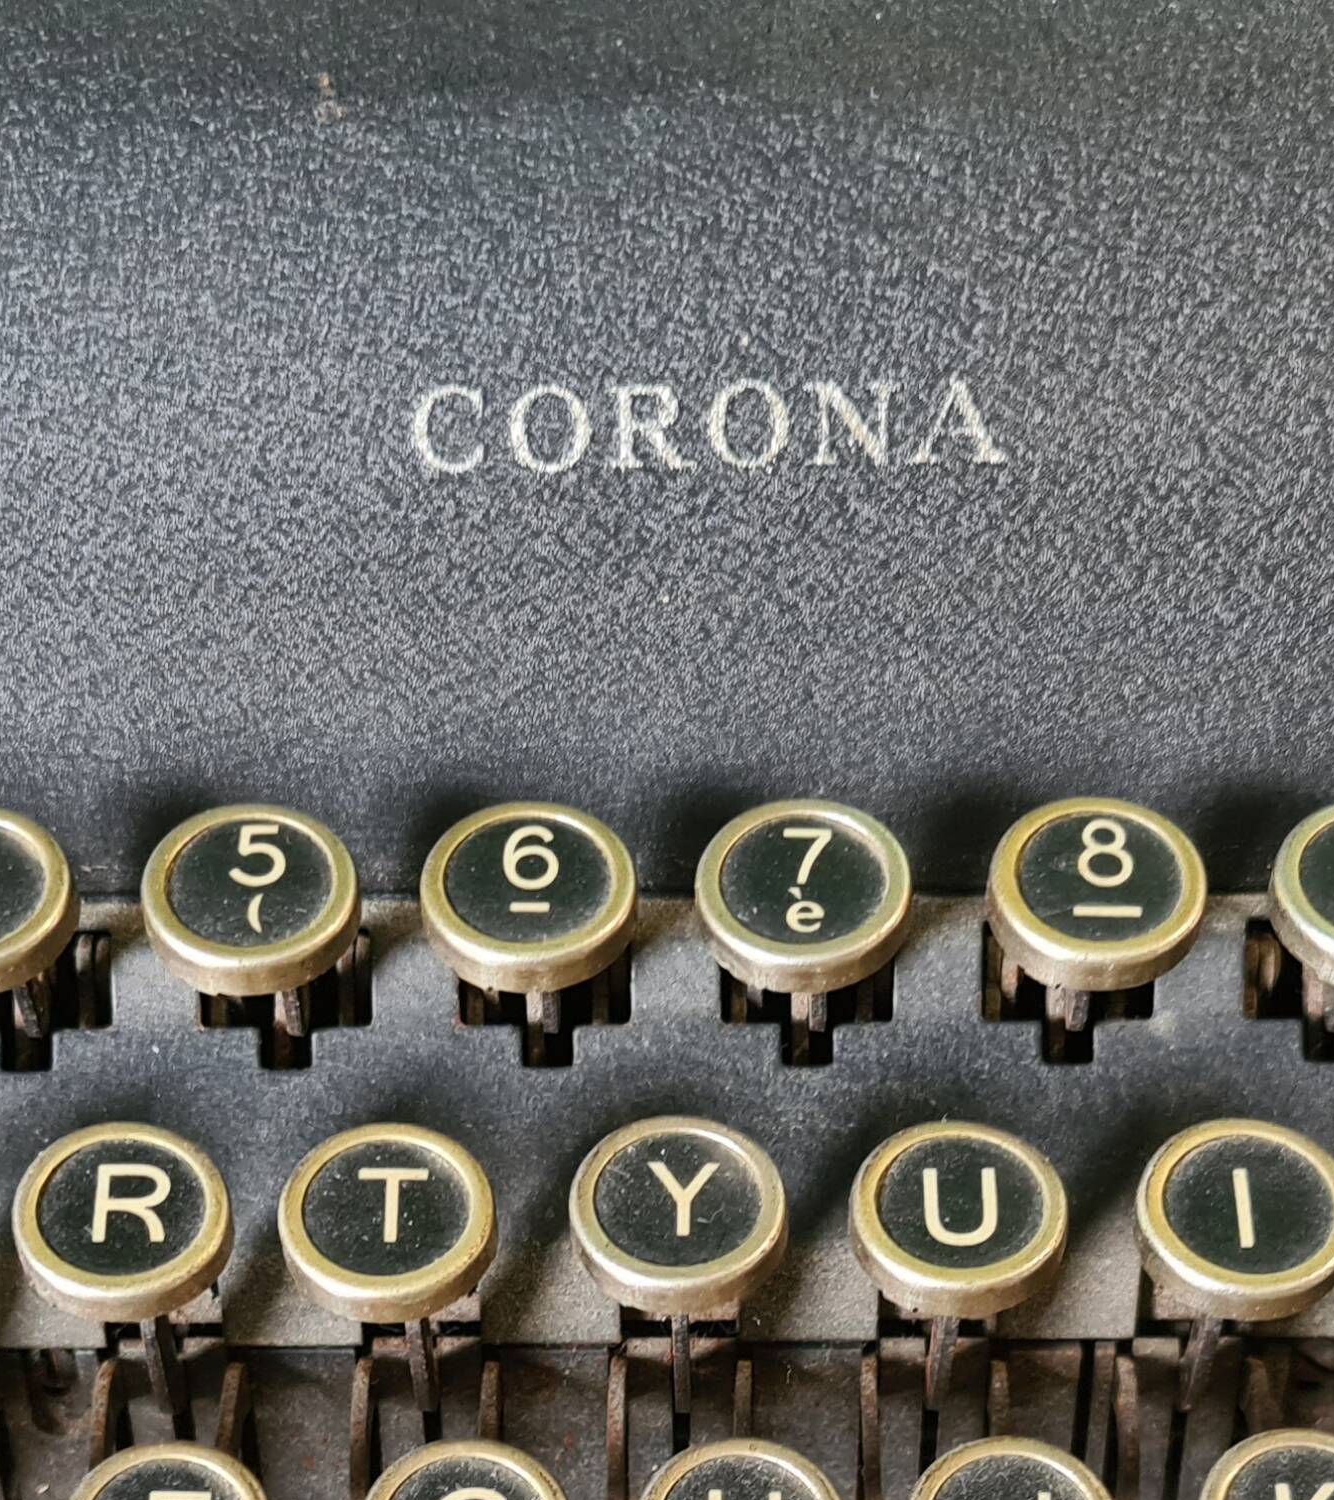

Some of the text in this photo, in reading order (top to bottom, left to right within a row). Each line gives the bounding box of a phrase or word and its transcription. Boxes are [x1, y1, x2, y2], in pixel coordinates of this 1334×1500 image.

[411, 375, 1007, 473] CORONA
[228, 821, 286, 887] 5
[503, 825, 559, 889] 6
[783, 828, 832, 884] 7
[1078, 819, 1133, 886] 8
[786, 887, 824, 933] è
[91, 1164, 171, 1242] R
[358, 1168, 429, 1242] T
[648, 1161, 720, 1236] Y
[923, 1168, 997, 1246] U
[1233, 1168, 1255, 1248] I
